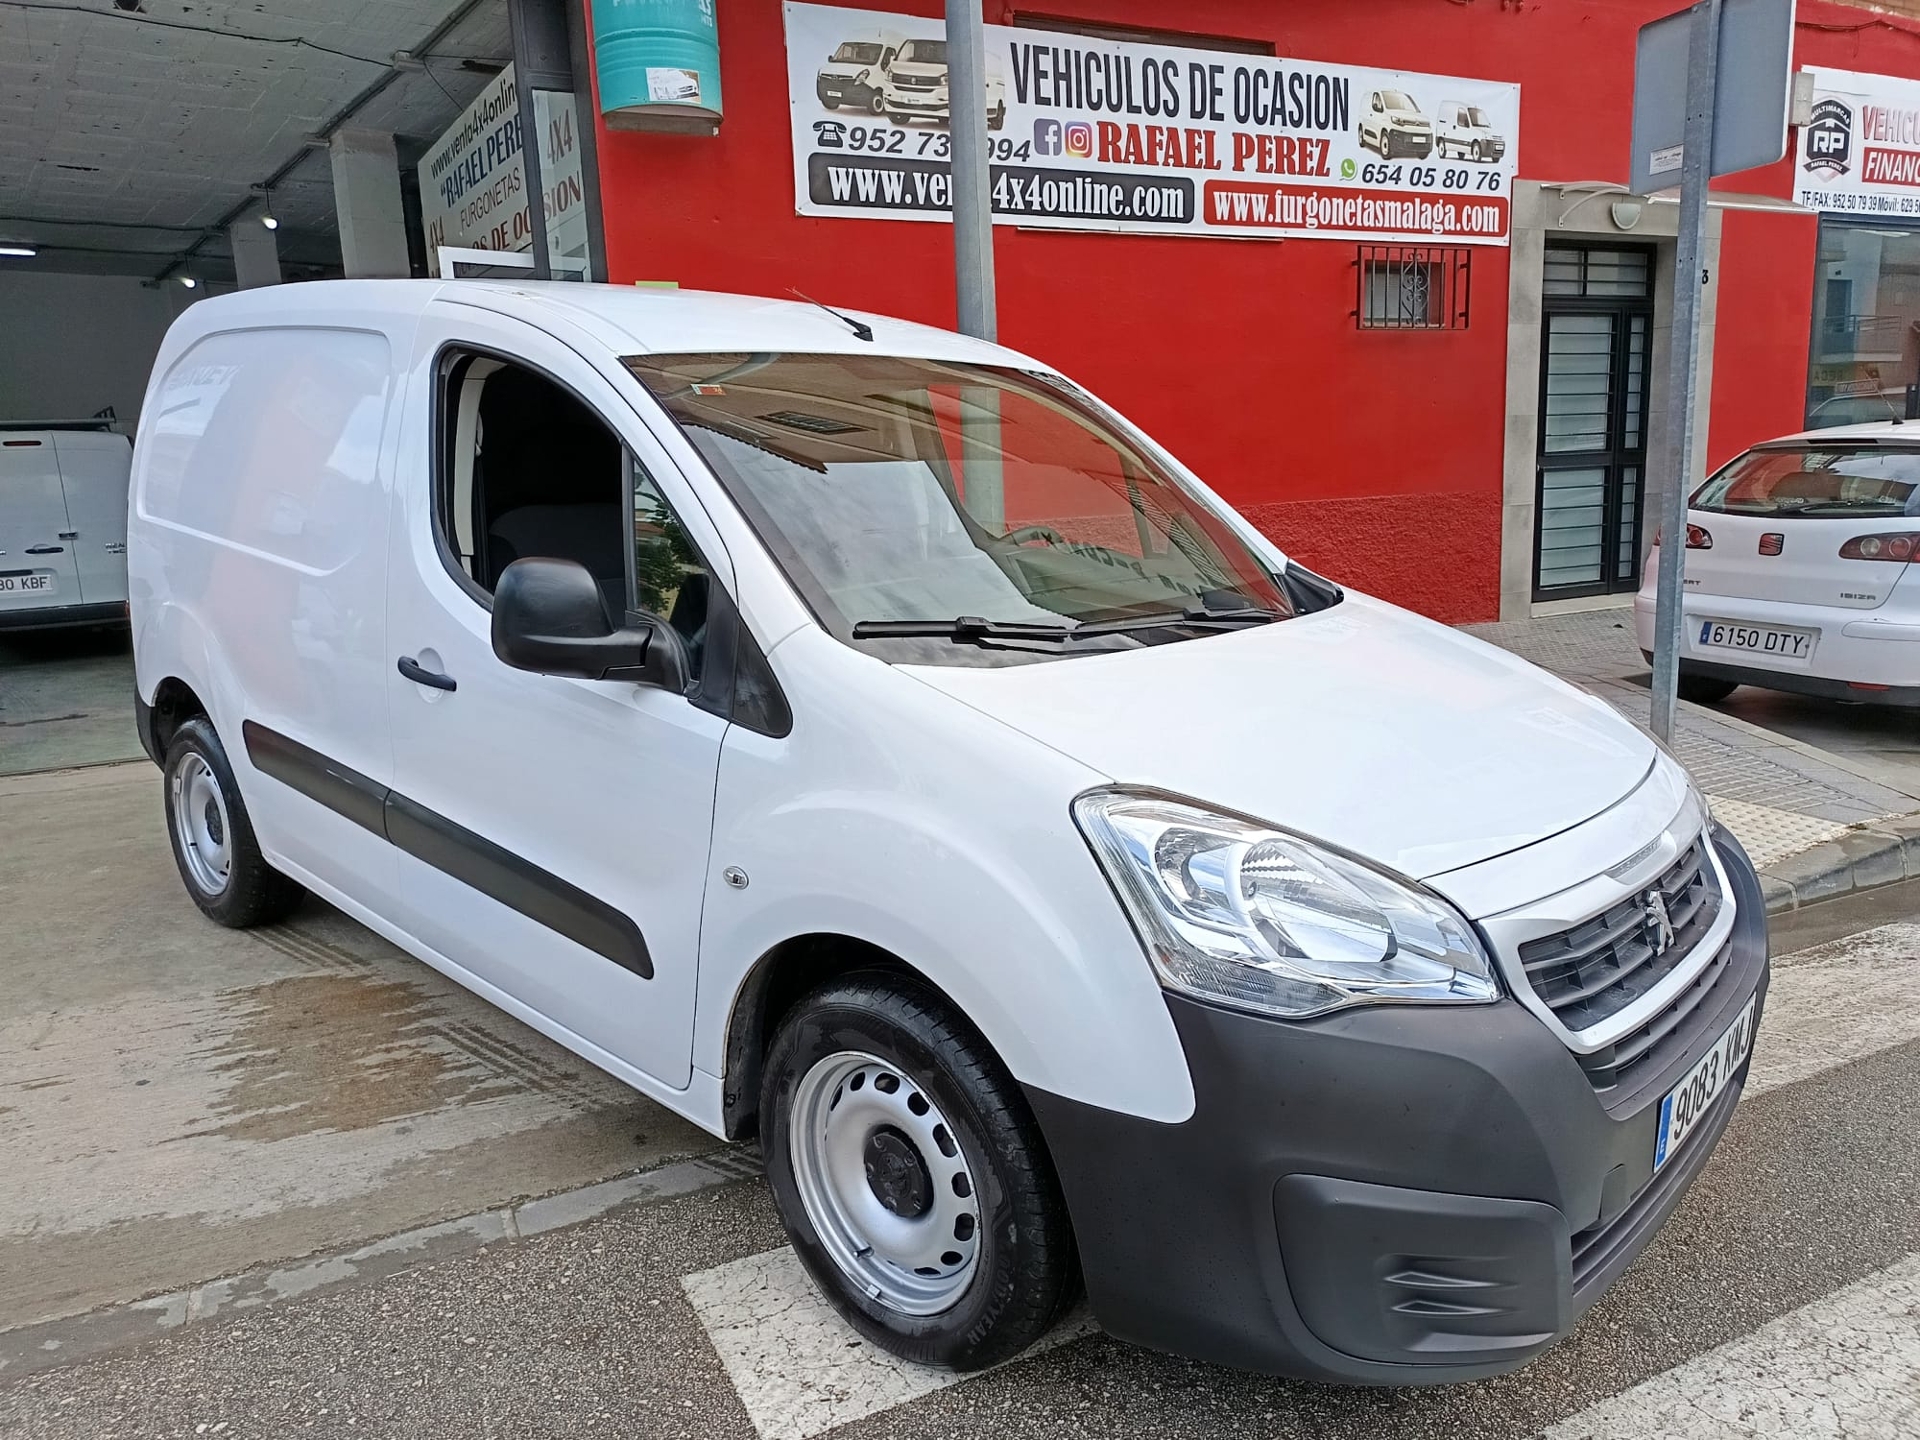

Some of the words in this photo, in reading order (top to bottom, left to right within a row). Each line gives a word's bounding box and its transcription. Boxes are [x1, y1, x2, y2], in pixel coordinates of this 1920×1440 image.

[1010, 42, 1180, 118] VEHICULOS
[1189, 62, 1225, 121] DE
[1234, 66, 1349, 132] OCASION
[431, 78, 516, 179] www.venta4x4onlin
[1811, 104, 1850, 124] MULTIMARCAS
[848, 126, 906, 154] 952
[917, 132, 950, 158] 73
[1096, 120, 1222, 170] RAFAEL
[1232, 132, 1331, 178] PEREZ
[1813, 130, 1845, 153] RP
[827, 166, 1184, 220] www.ve4x4online.com
[1362, 164, 1402, 185] 654
[1409, 166, 1437, 188] 05
[1442, 169, 1469, 190] 80
[1476, 171, 1501, 192] 76
[461, 166, 521, 230] FURGONETAS
[1213, 189, 1500, 234] www.furgonetasmalaga.com
[1833, 193, 1846, 209] 952
[1847, 194, 1857, 209] 50
[1858, 195, 1867, 210] 79
[1868, 196, 1878, 211] 39
[1901, 198, 1914, 213] 629
[21, 576, 48, 590] KBF
[1713, 626, 1759, 648] 6150
[1764, 632, 1804, 654] DTY
[1674, 1050, 1719, 1140] 9083
